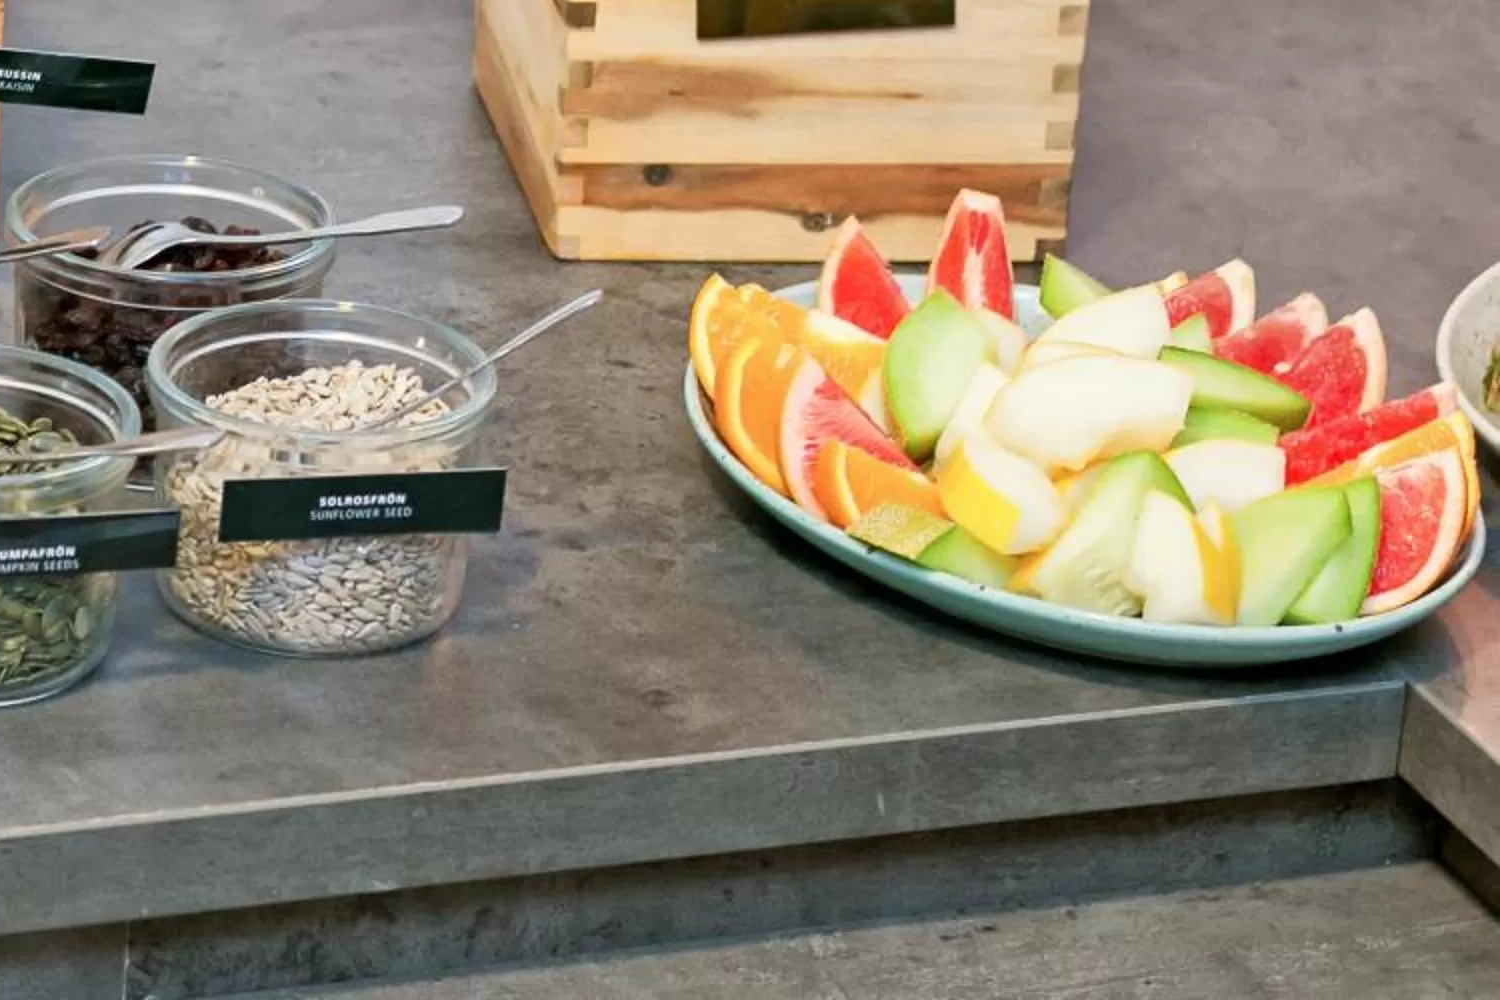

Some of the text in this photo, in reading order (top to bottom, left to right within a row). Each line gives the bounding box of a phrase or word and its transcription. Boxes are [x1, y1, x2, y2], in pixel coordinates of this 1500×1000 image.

[309, 505, 414, 521] SUNFLOWER SEED
[42, 558, 80, 572] SEEDS
